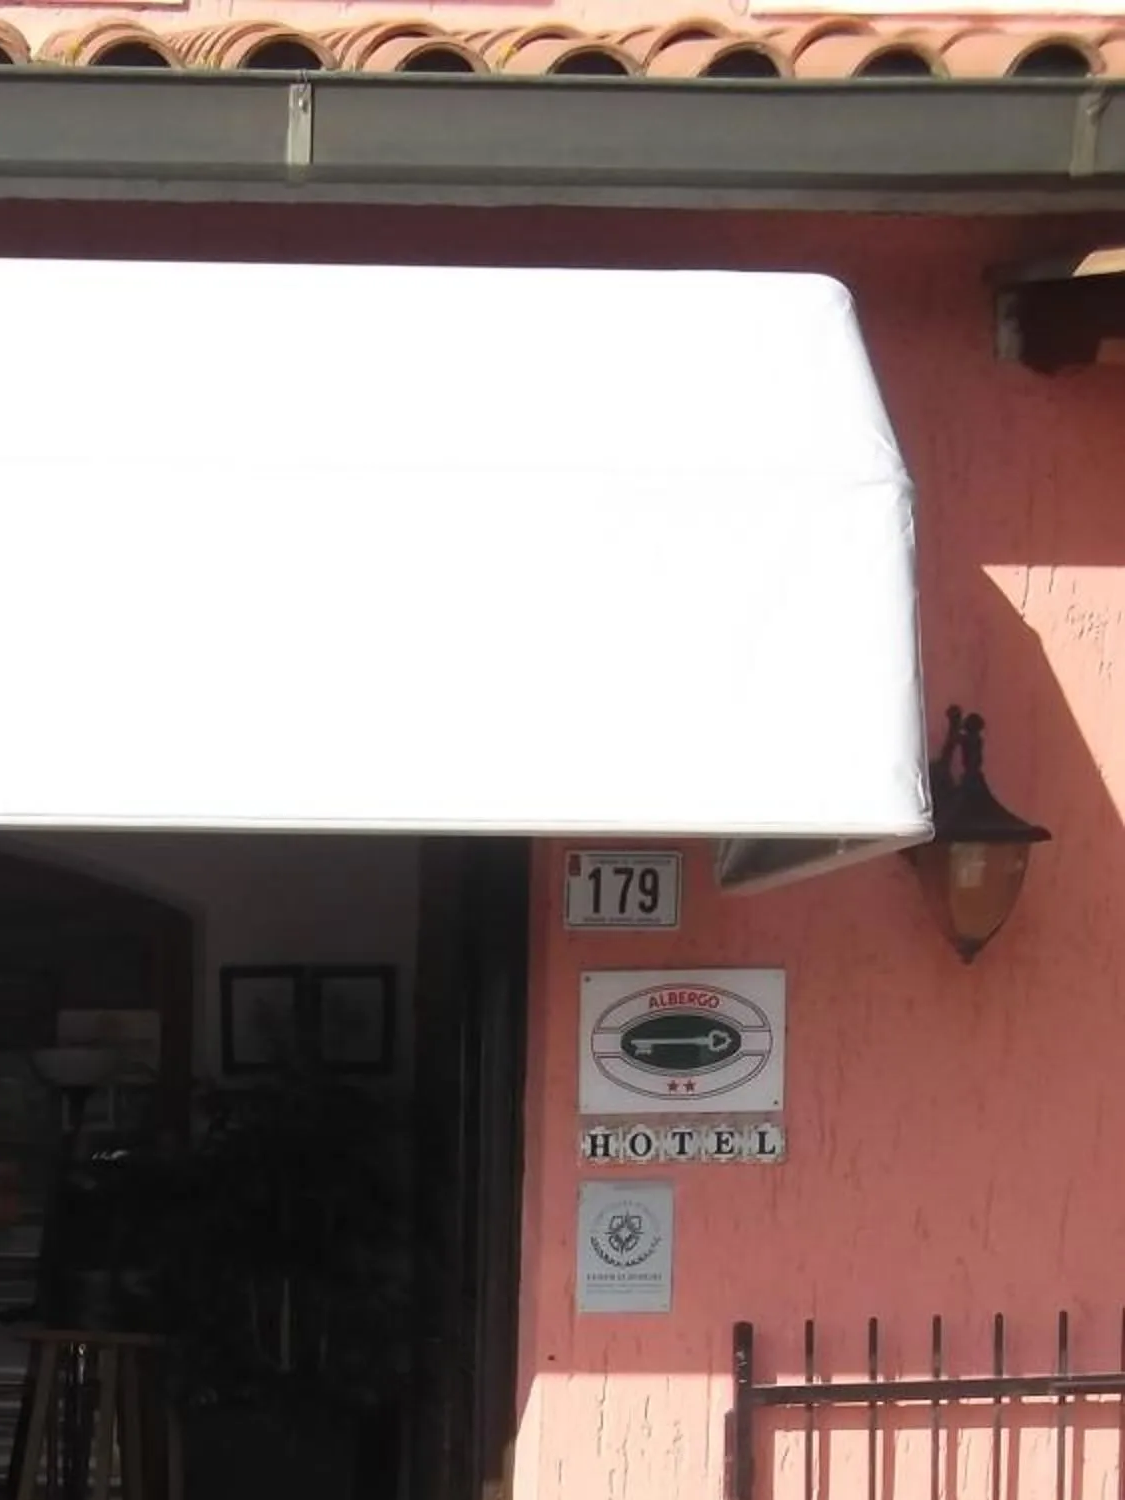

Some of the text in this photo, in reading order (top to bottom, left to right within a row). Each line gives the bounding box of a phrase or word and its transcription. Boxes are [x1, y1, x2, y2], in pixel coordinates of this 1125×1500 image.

[588, 866, 660, 914] 179
[648, 991, 720, 1009] ALBERGO
[587, 1131, 776, 1157] HOTEL
